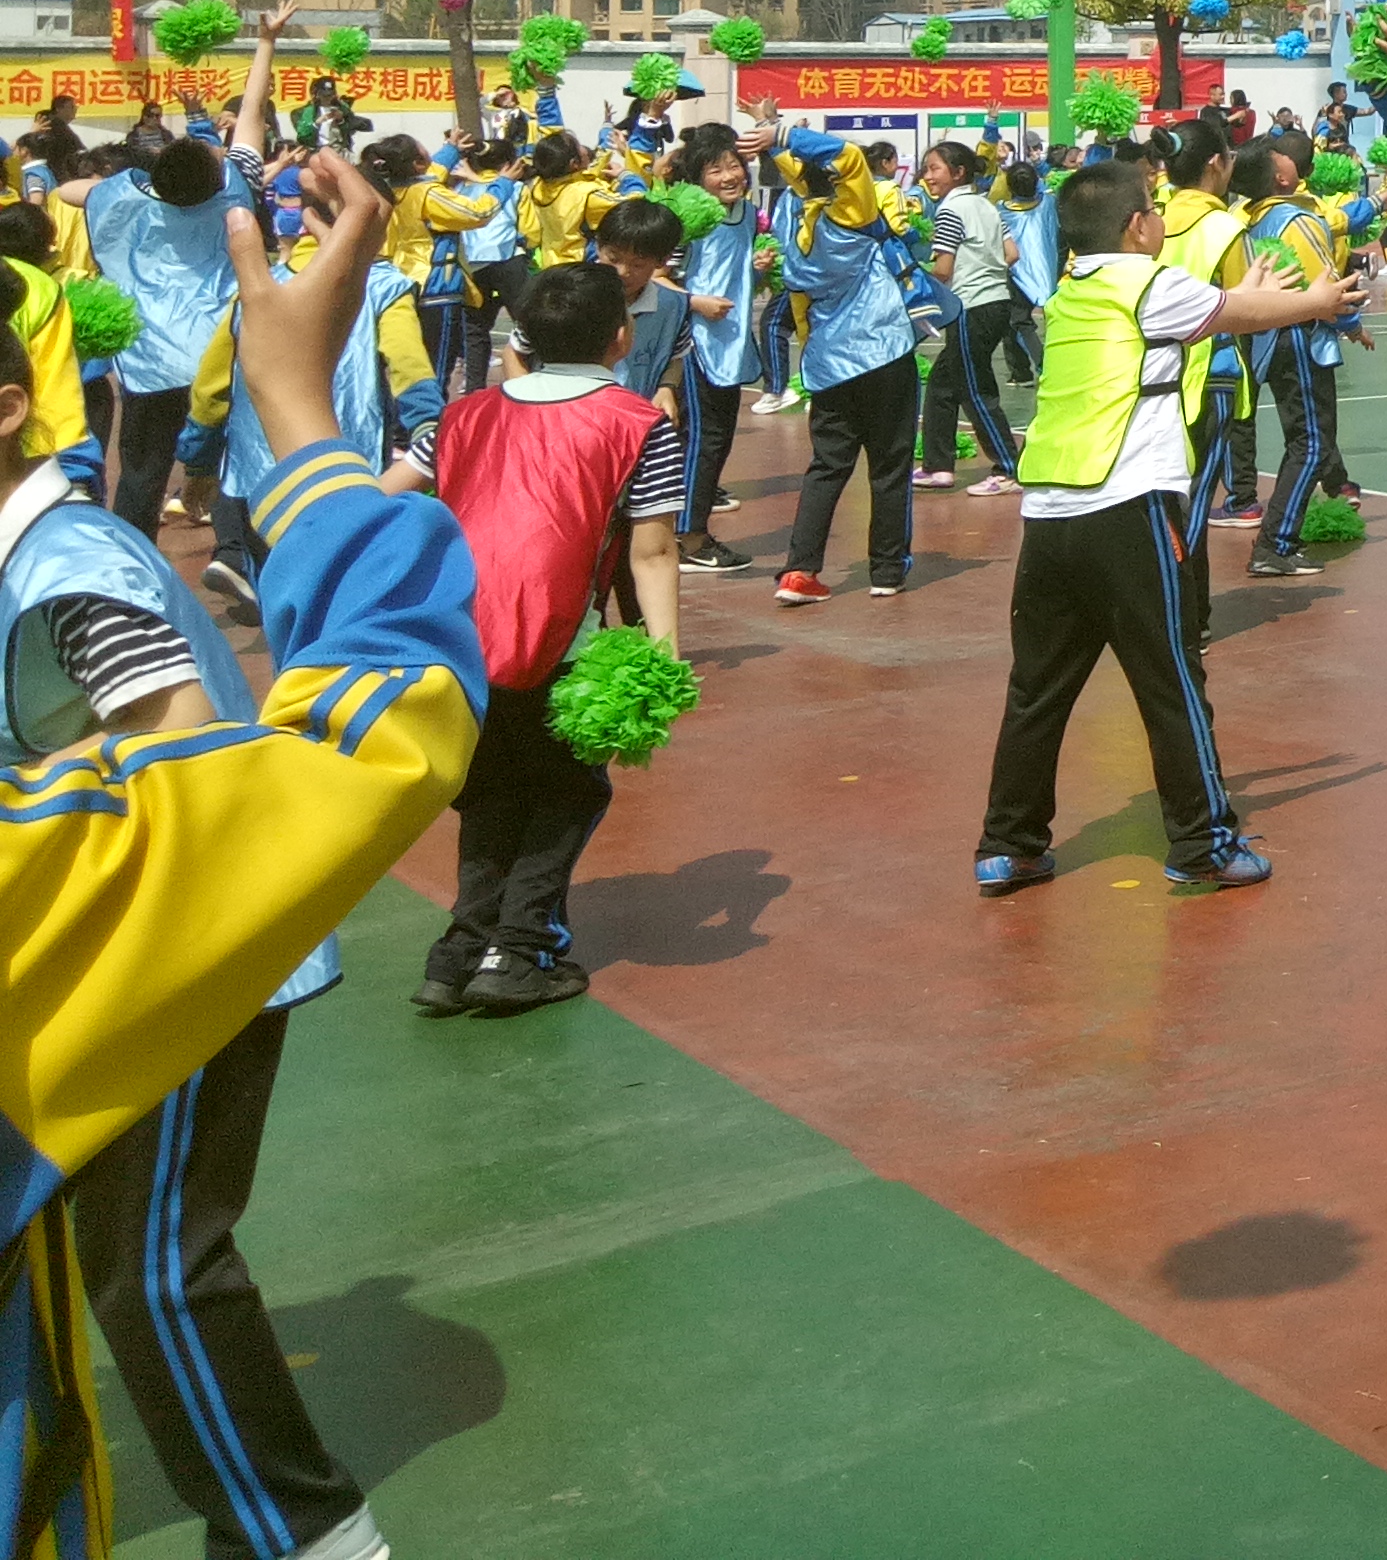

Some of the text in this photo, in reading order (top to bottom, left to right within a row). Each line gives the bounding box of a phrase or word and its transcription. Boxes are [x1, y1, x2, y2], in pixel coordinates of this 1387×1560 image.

[797, 67, 992, 99] 体育无处不在
